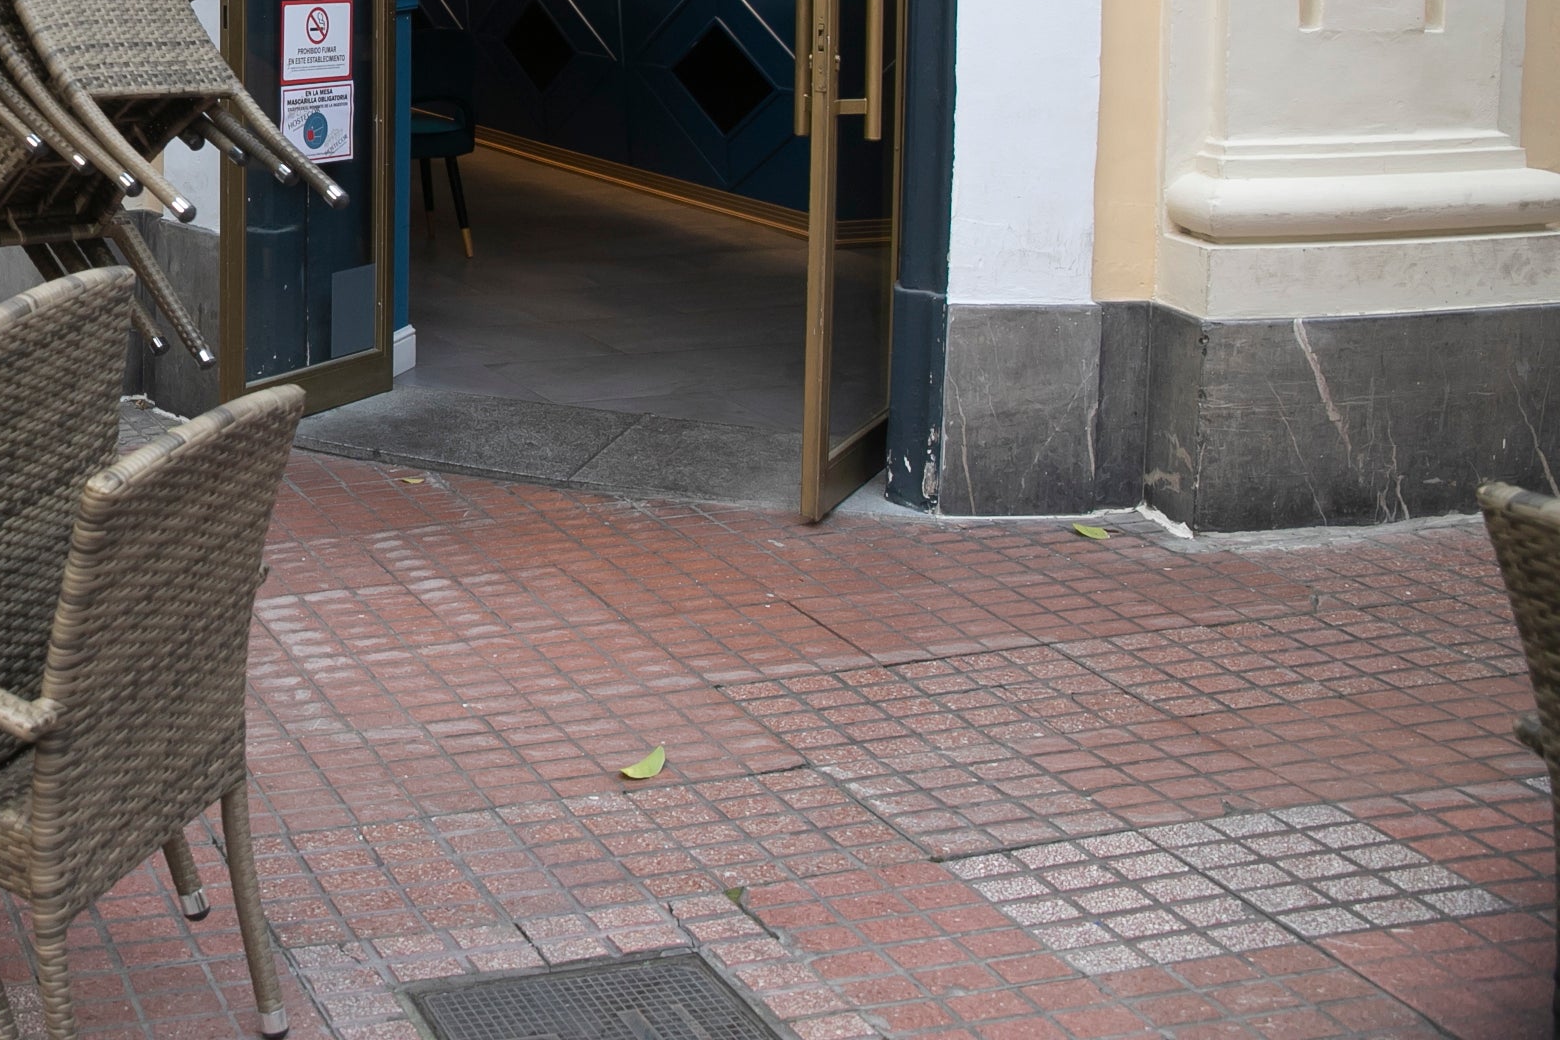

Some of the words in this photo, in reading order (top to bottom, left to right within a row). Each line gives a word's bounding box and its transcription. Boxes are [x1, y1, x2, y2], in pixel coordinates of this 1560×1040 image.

[297, 47, 322, 55] PROHIBIDO
[306, 54, 346, 64] ESTABLECIMIENTO
[287, 97, 317, 106] MASCARILLA
[318, 94, 348, 103] OBLIGATORIA
